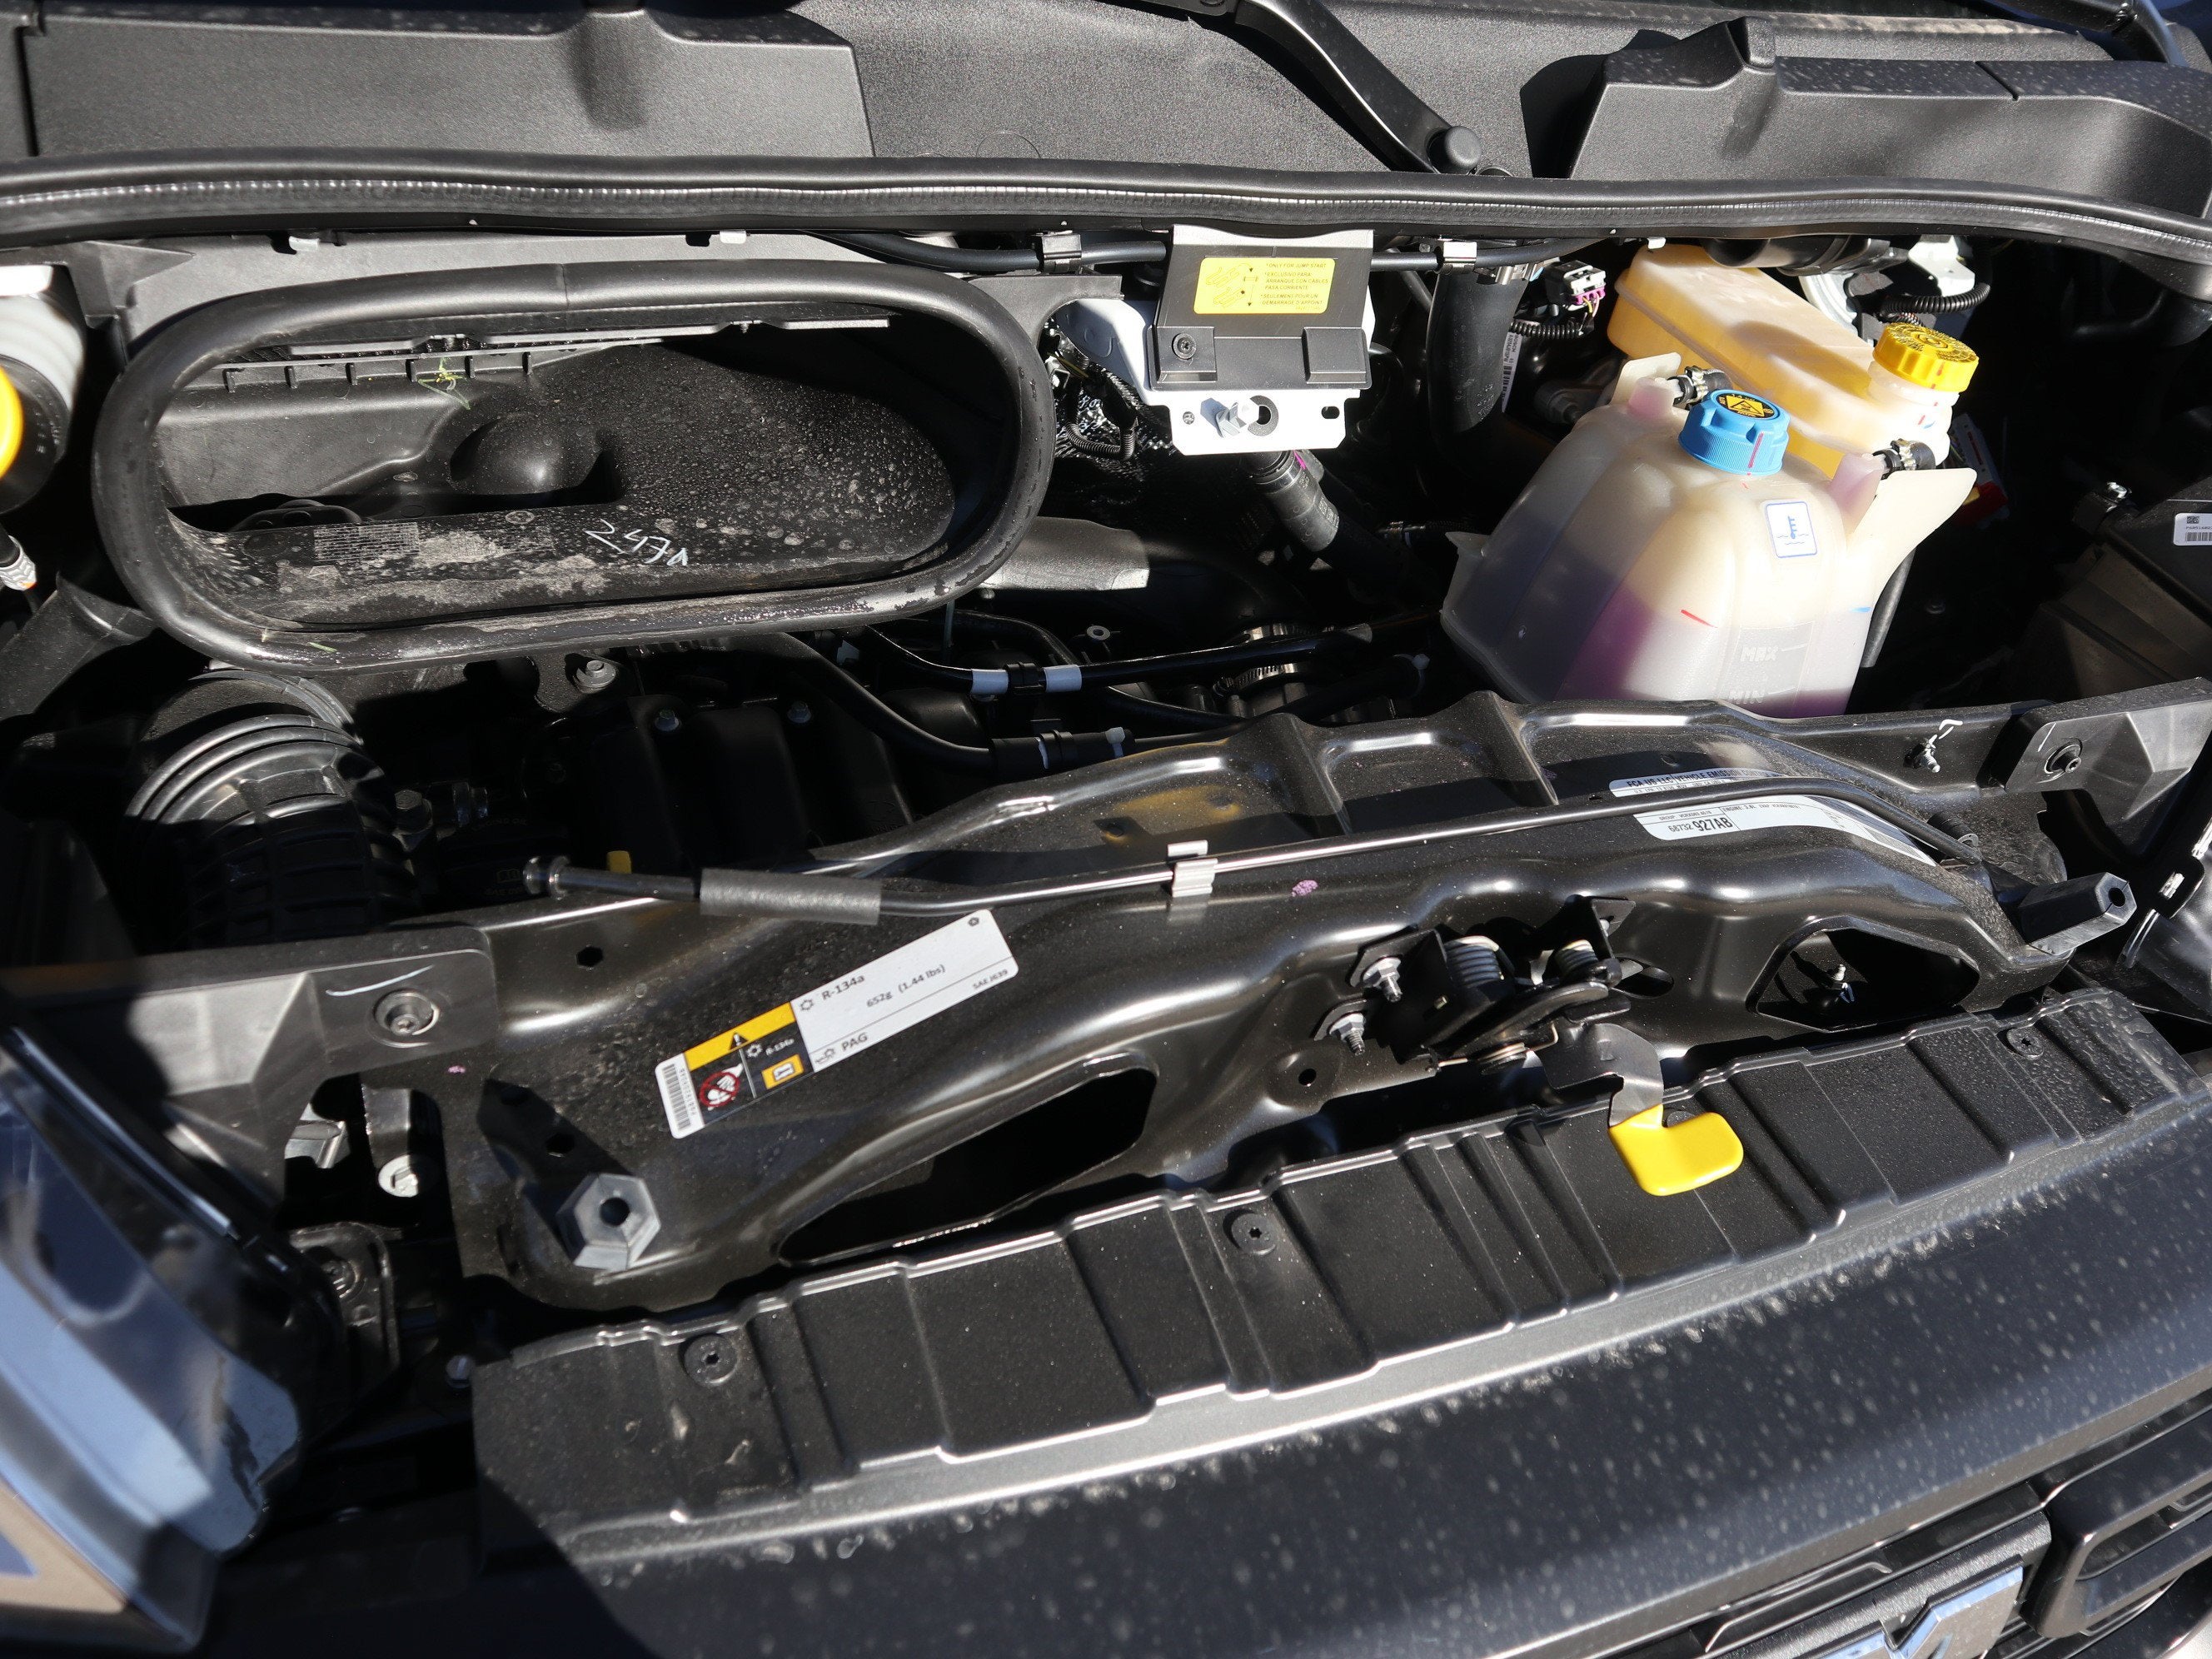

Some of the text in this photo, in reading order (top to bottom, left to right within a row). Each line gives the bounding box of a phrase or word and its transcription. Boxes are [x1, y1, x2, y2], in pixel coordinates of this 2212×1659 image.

[1740, 645, 1778, 662] MAX
[1727, 689, 1765, 703] MIN
[1657, 776, 1674, 785] LLC
[1674, 773, 1706, 782] VEHICLE
[1707, 770, 1740, 778] EMISSION
[1668, 817, 1733, 832] 68732 927AB
[821, 974, 865, 1000] R-134a
[867, 964, 946, 1008] 652g (1.44 lbs)
[973, 979, 988, 989] SAE
[841, 1033, 868, 1051] PAG
